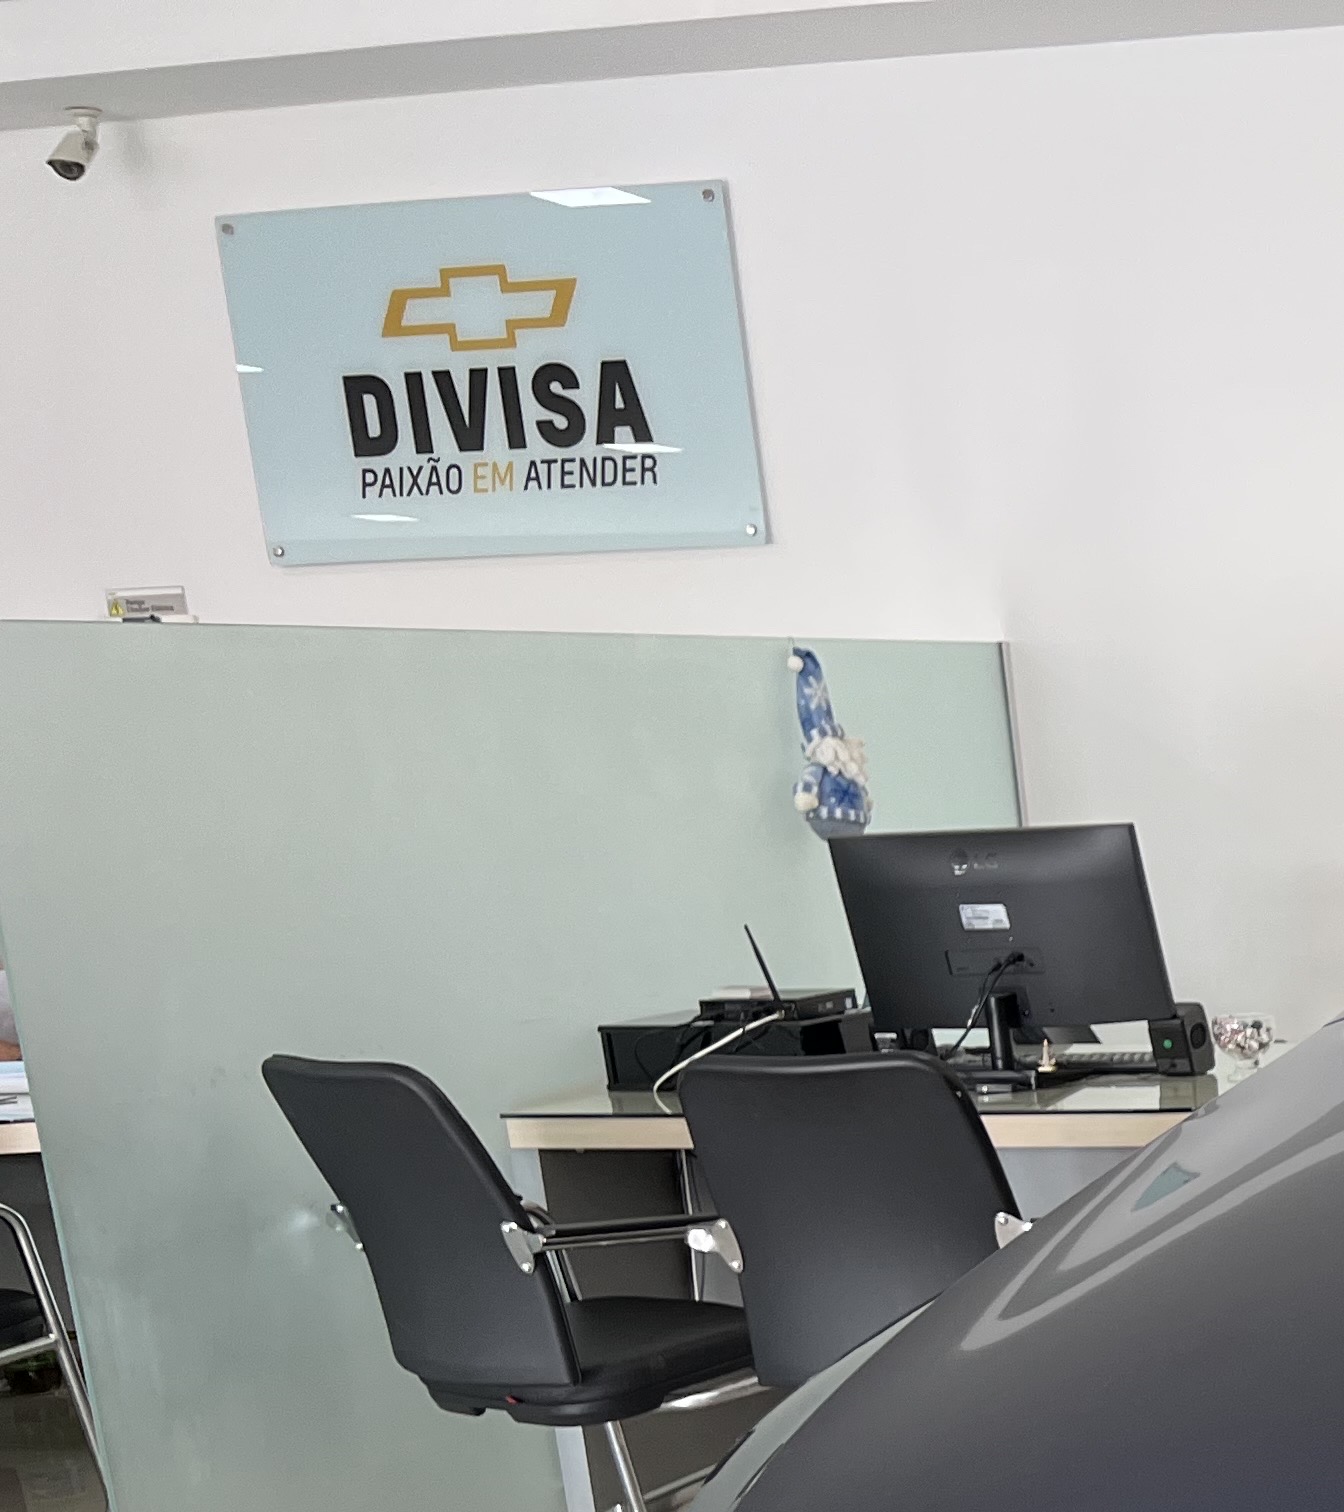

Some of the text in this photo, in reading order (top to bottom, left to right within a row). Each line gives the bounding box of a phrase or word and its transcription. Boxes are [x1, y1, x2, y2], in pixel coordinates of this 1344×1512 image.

[342, 359, 654, 458] DIVISA
[361, 455, 658, 499] PAIXÃO EM ATENDER
